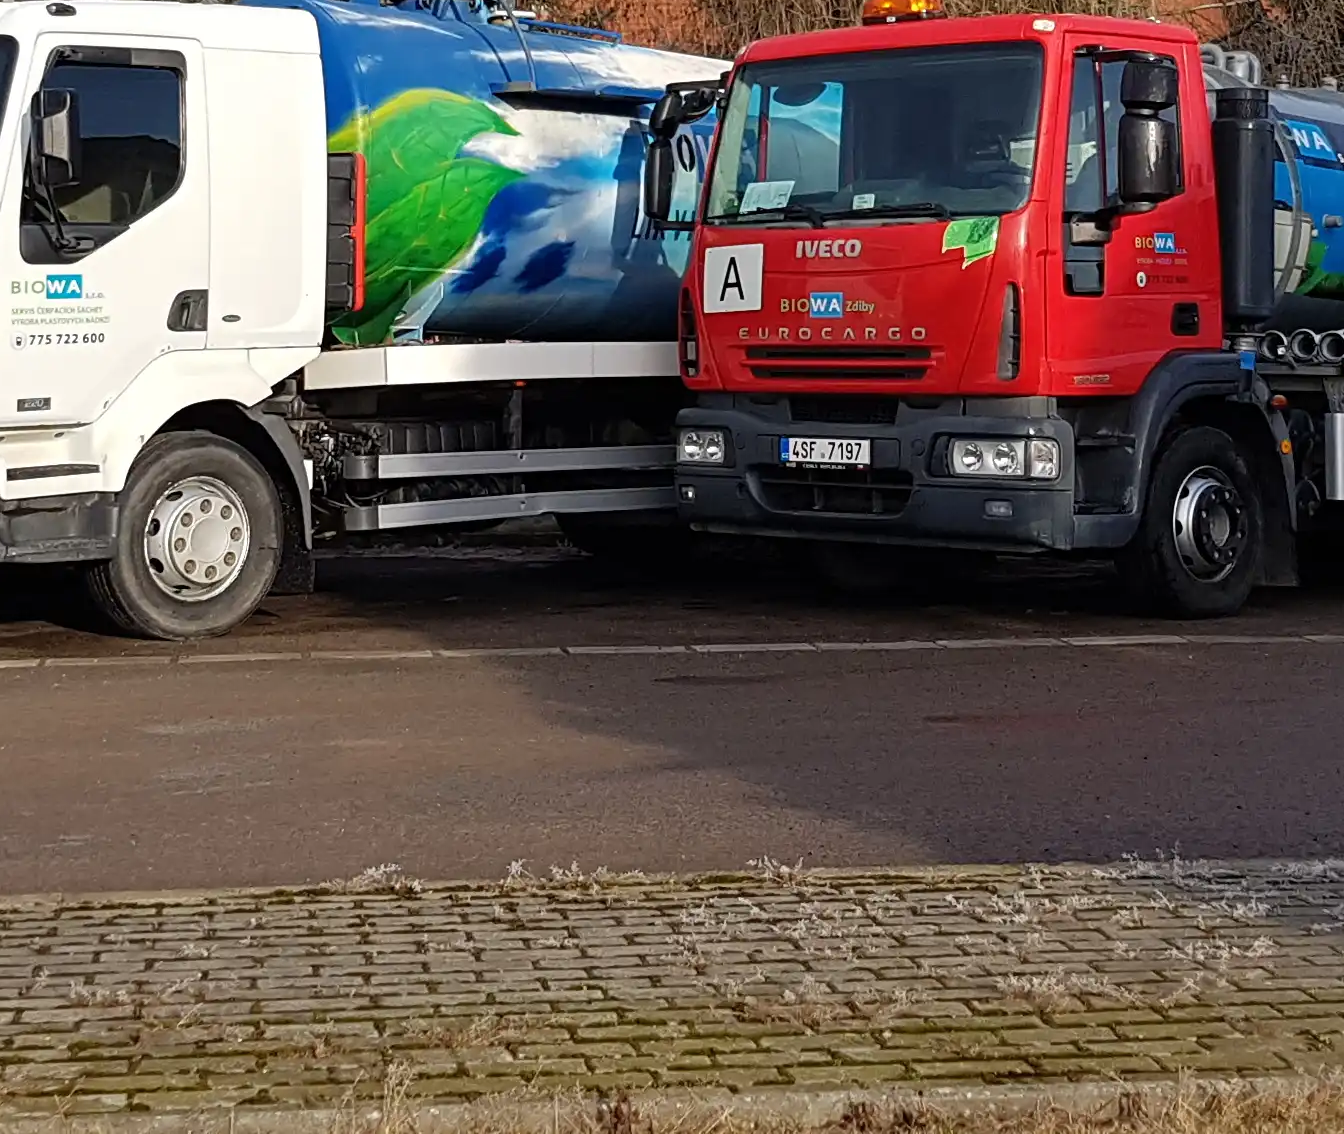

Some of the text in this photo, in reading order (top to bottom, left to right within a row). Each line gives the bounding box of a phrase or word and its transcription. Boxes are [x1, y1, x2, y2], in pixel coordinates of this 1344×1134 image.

[795, 239, 862, 259] IVECO
[1135, 237, 1173, 249] BIOWA
[719, 256, 745, 301] A
[11, 280, 81, 294] BIOWA
[780, 297, 875, 314] BIOWA Zdiby
[29, 332, 105, 345] 775 722 600
[739, 327, 926, 340] EUROCARGO
[792, 441, 862, 461] 4SF 7197
